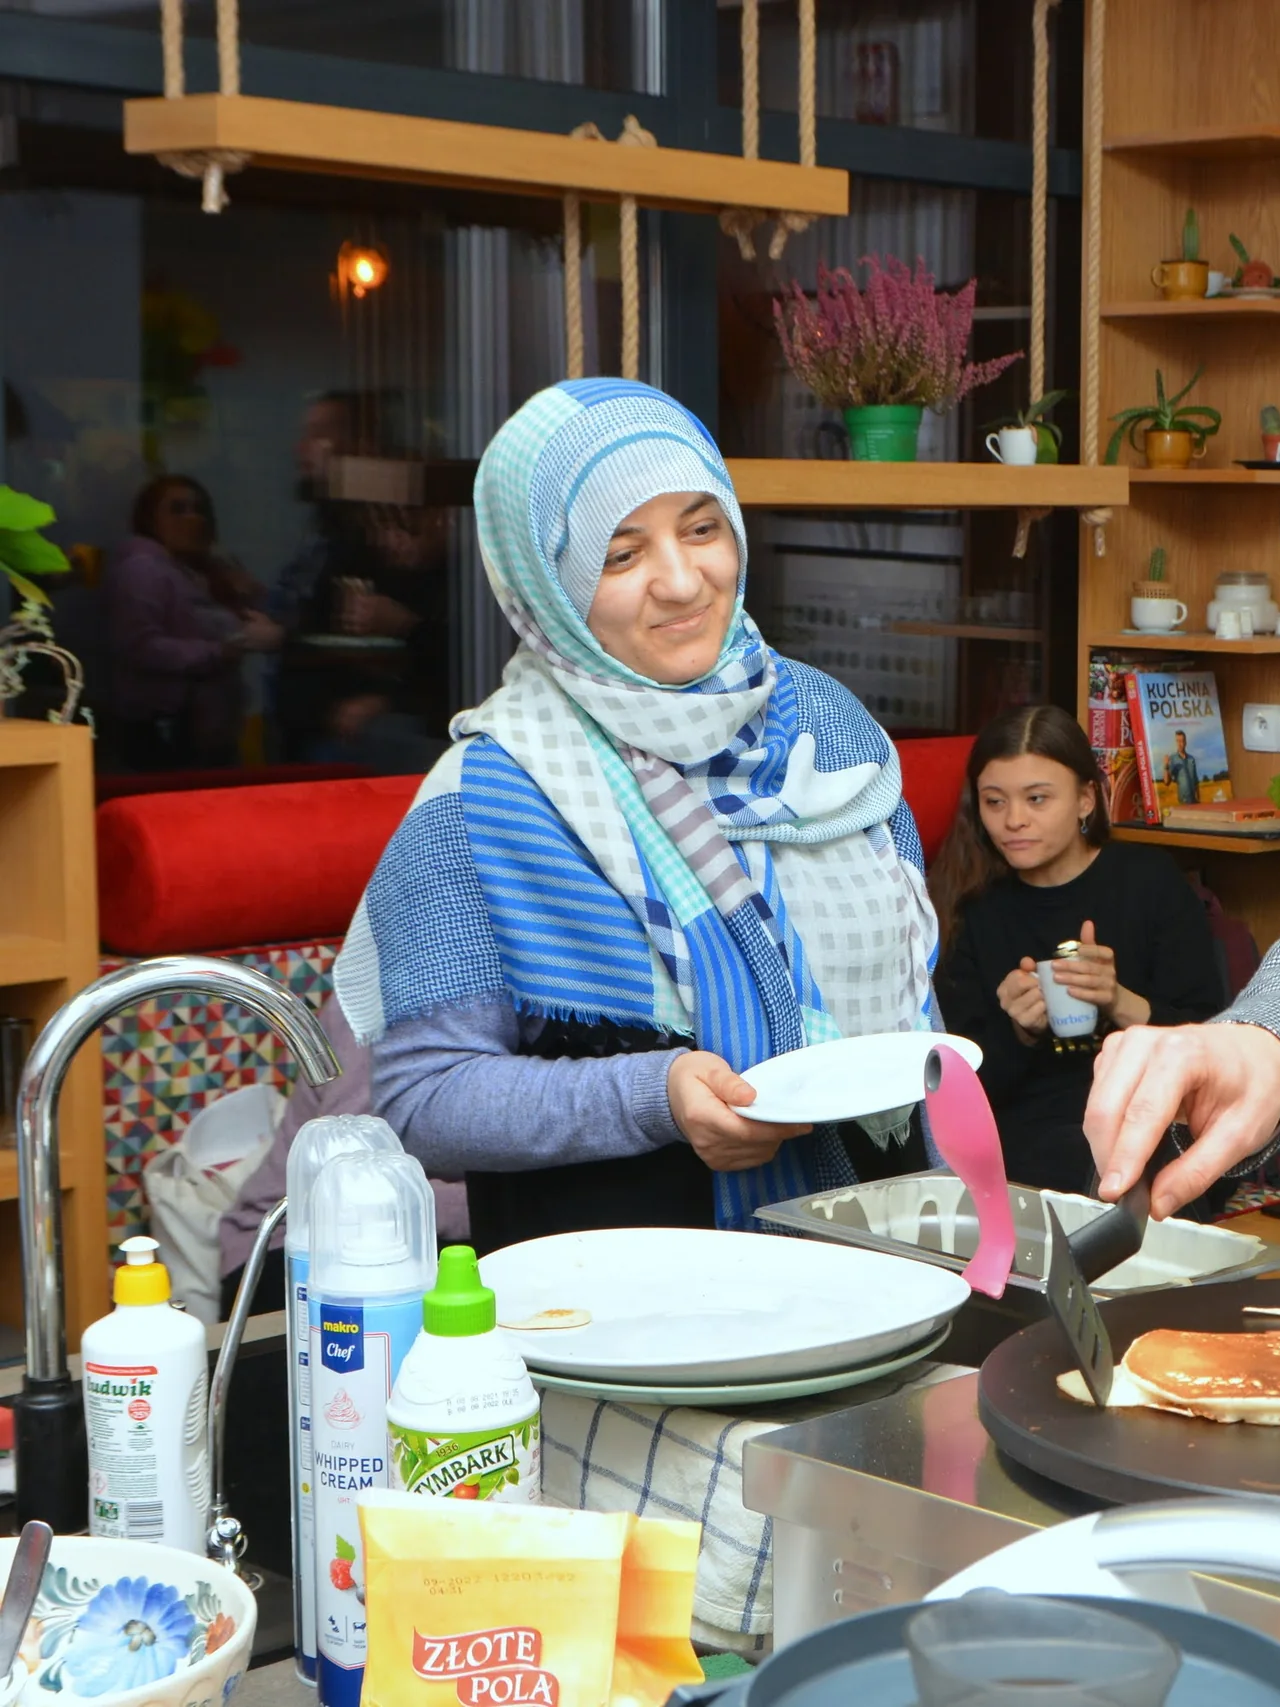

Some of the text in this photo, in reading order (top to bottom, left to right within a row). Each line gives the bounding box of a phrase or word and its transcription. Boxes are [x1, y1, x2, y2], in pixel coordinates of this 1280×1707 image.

[1146, 680, 1210, 699] KUCHNIA
[1149, 698, 1214, 719] POLSKA
[323, 1321, 360, 1334] makro
[326, 1342, 356, 1362] Chef
[331, 1440, 355, 1450] DAIRY
[435, 1443, 460, 1459] 1936
[314, 1450, 384, 1473] WHIPPED
[414, 1442, 510, 1497] TYMBARK
[320, 1471, 373, 1491] CREAM
[422, 1631, 536, 1672] ZŁOTE
[469, 1673, 553, 1705] POLA
